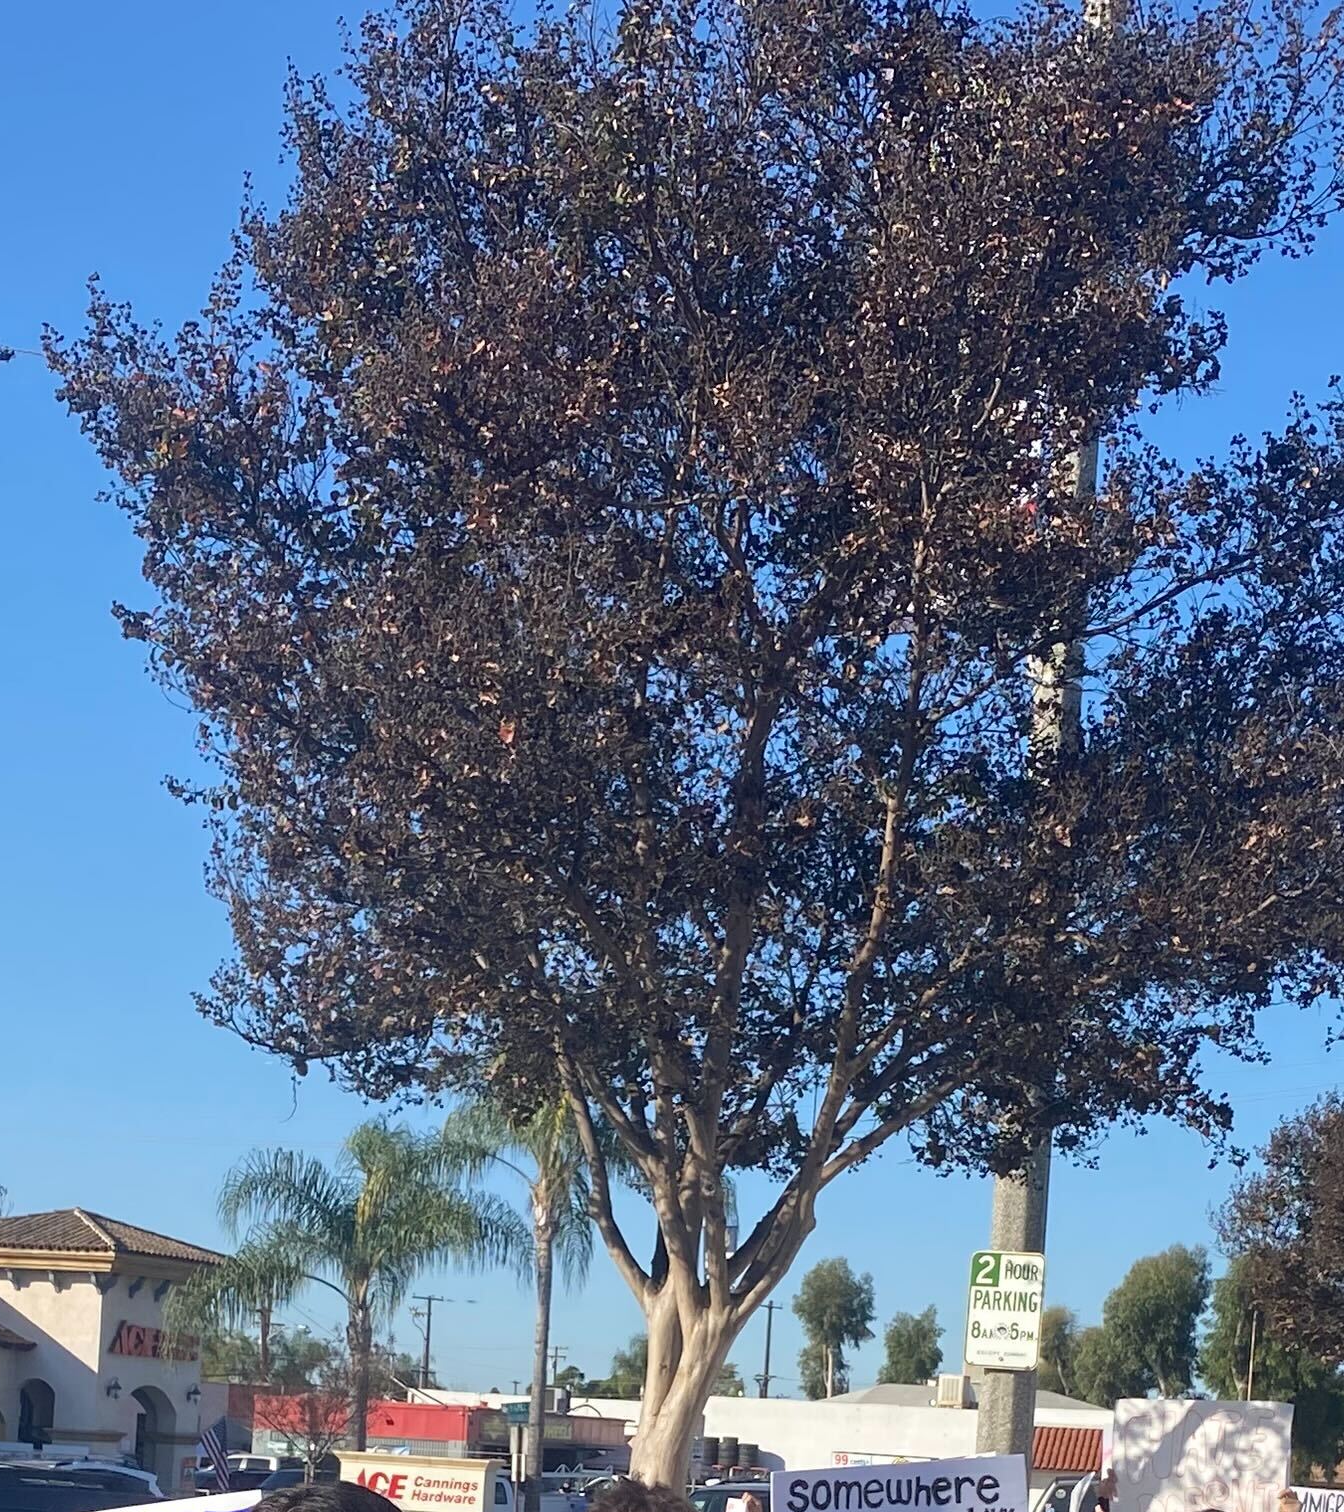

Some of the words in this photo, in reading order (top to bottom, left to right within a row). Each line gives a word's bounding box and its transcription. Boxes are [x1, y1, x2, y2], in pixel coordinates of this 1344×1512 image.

[975, 1254, 996, 1284] 2
[1004, 1260, 1039, 1281] HOUR
[972, 1289, 1039, 1312] PARKING
[1009, 1322, 1034, 1340] 6PM
[834, 1454, 849, 1466] 99
[413, 1475, 479, 1492] Cannings
[411, 1488, 476, 1506] Hardware
